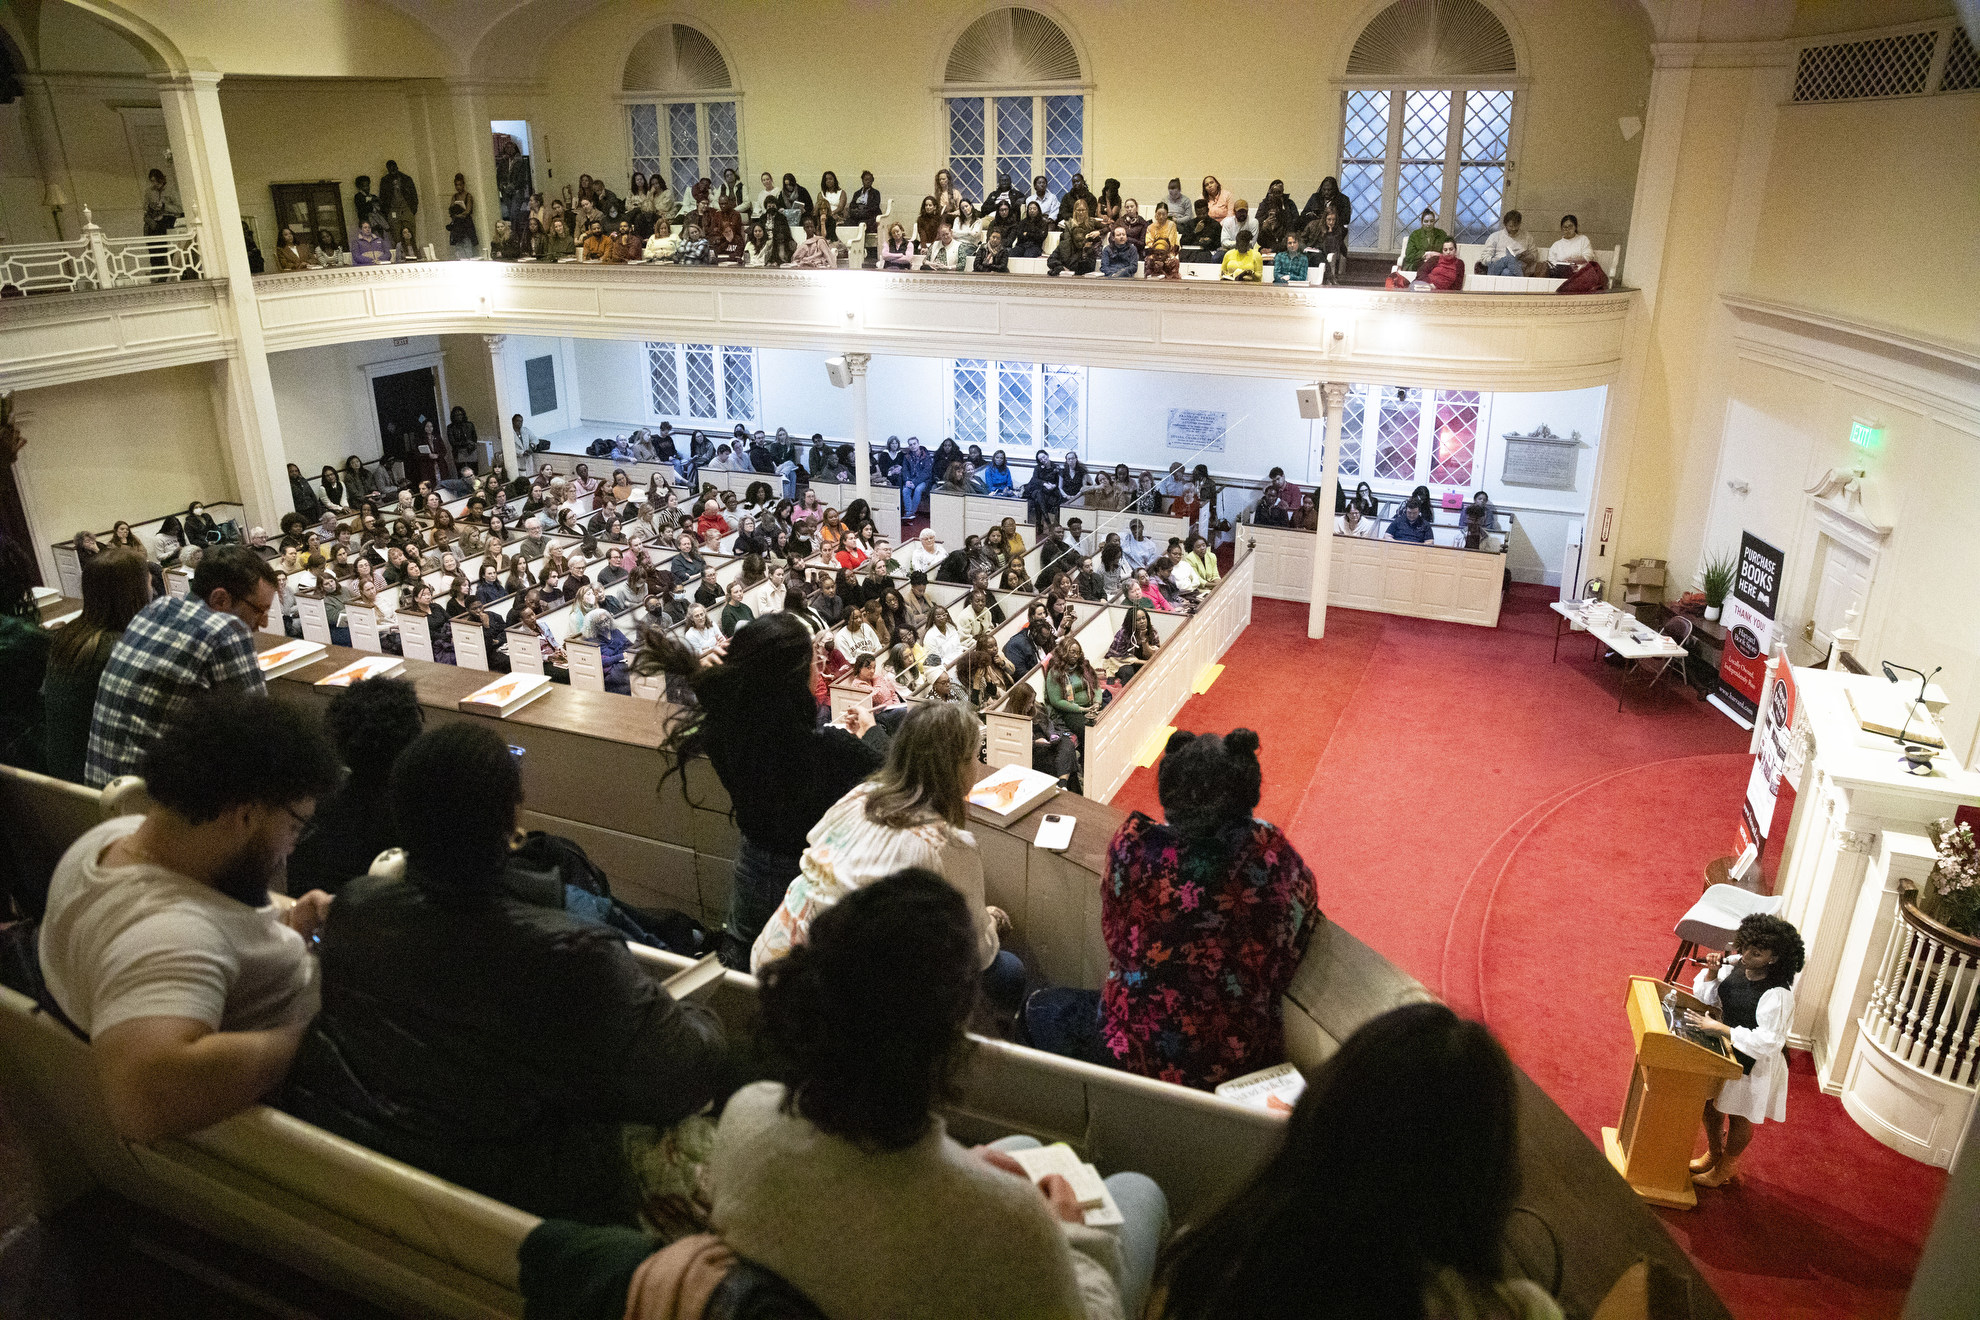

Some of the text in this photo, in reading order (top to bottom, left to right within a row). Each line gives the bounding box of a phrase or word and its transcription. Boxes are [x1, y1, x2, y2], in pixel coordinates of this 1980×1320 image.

[1852, 424, 1870, 447] EXIT
[1744, 546, 1776, 575] PURCHASE
[1738, 578, 1758, 598] HERE
[1741, 560, 1773, 592] BOOKS
[1734, 605, 1766, 632] THANK YOU!
[1738, 628, 1756, 645] Harvard
[1728, 655, 1741, 669] Locally
[1718, 686, 1754, 715] www.harvard.com
